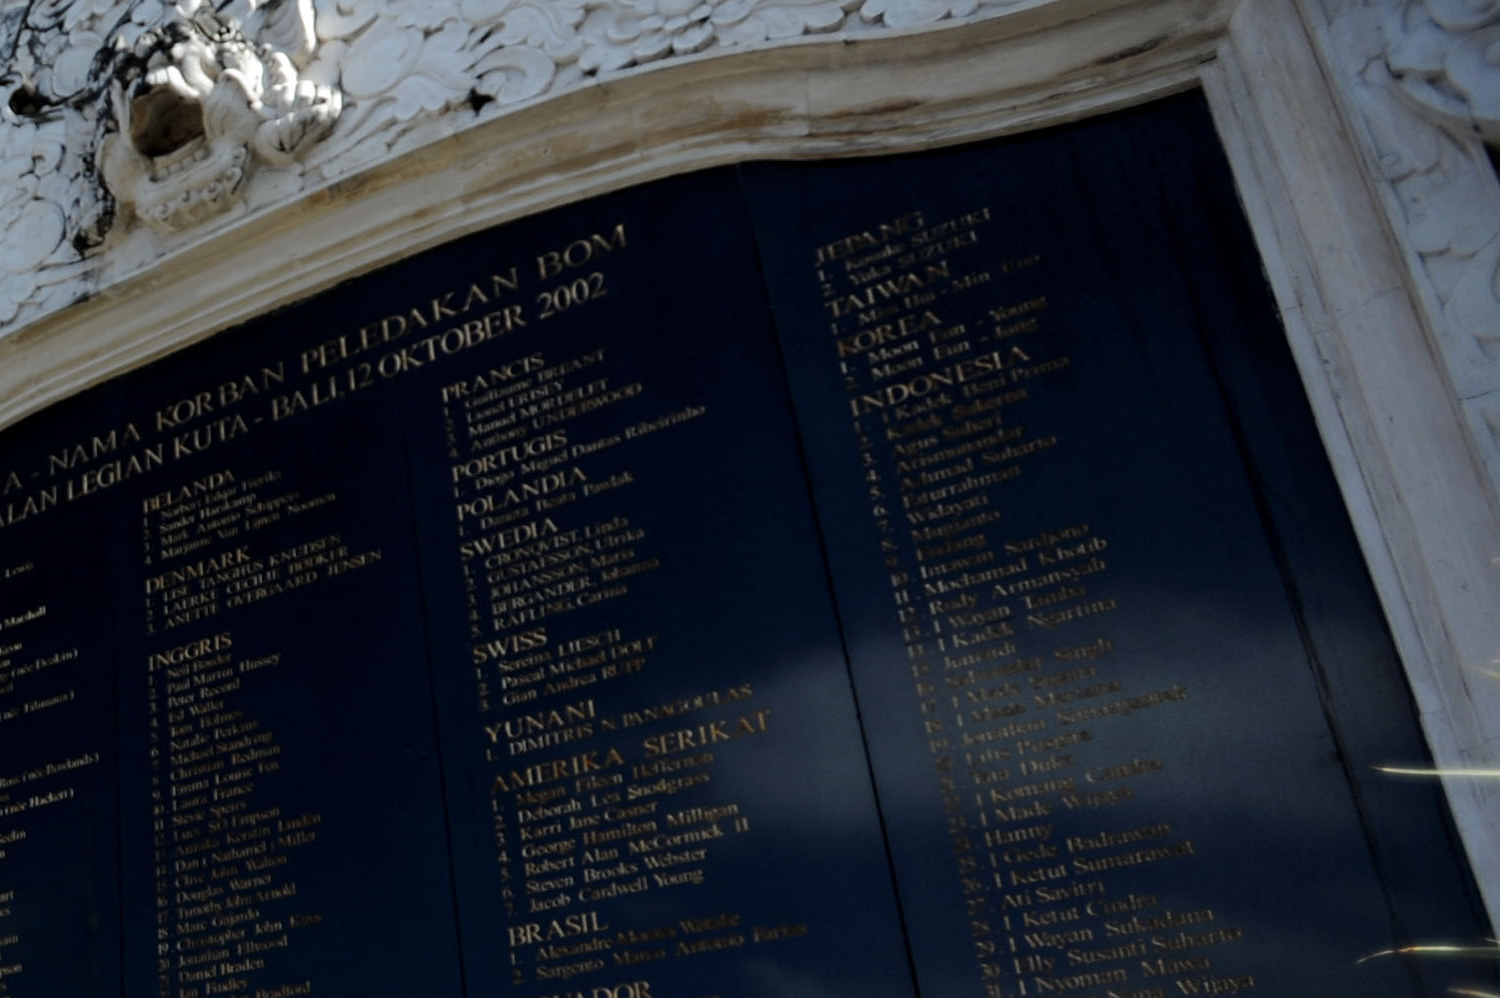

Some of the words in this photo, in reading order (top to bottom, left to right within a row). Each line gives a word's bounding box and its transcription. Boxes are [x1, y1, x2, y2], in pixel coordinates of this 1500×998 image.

[815, 210, 924, 267] JEPANG
[825, 260, 949, 318] TAIWAN
[49, 422, 141, 476] NAMA
[155, 361, 285, 431] KORBAN
[300, 267, 520, 375] PELEDAKAN
[535, 223, 628, 281] BOM
[836, 310, 942, 357] KOREA
[66, 443, 164, 501] LEGIAN
[172, 413, 249, 460] KUTA
[377, 303, 529, 379] OKTOBER
[534, 271, 607, 321] 2002
[442, 352, 545, 402] PRANCIS
[850, 345, 1032, 417] INDONESIA
[452, 429, 568, 483] PORTUGIS
[142, 468, 236, 514] BELANDA
[457, 466, 587, 521] POLANDIA
[460, 517, 558, 561] SWEDIA
[145, 544, 251, 595] DENMARK
[148, 631, 233, 672] INGGRIS
[473, 627, 547, 664] SWISS
[484, 699, 596, 744] YUNANI
[509, 723, 594, 756] DIMITRIS
[491, 748, 624, 795] AMERIKA
[644, 709, 771, 757] SERIKAT
[518, 799, 581, 824] Deborah
[583, 818, 658, 846] Hamilton
[524, 855, 575, 877] Robert
[583, 862, 640, 884] Brooks
[644, 847, 708, 871] Webster
[529, 892, 571, 913] Jacob
[654, 867, 704, 888] Young
[508, 910, 609, 948] BRASIL
